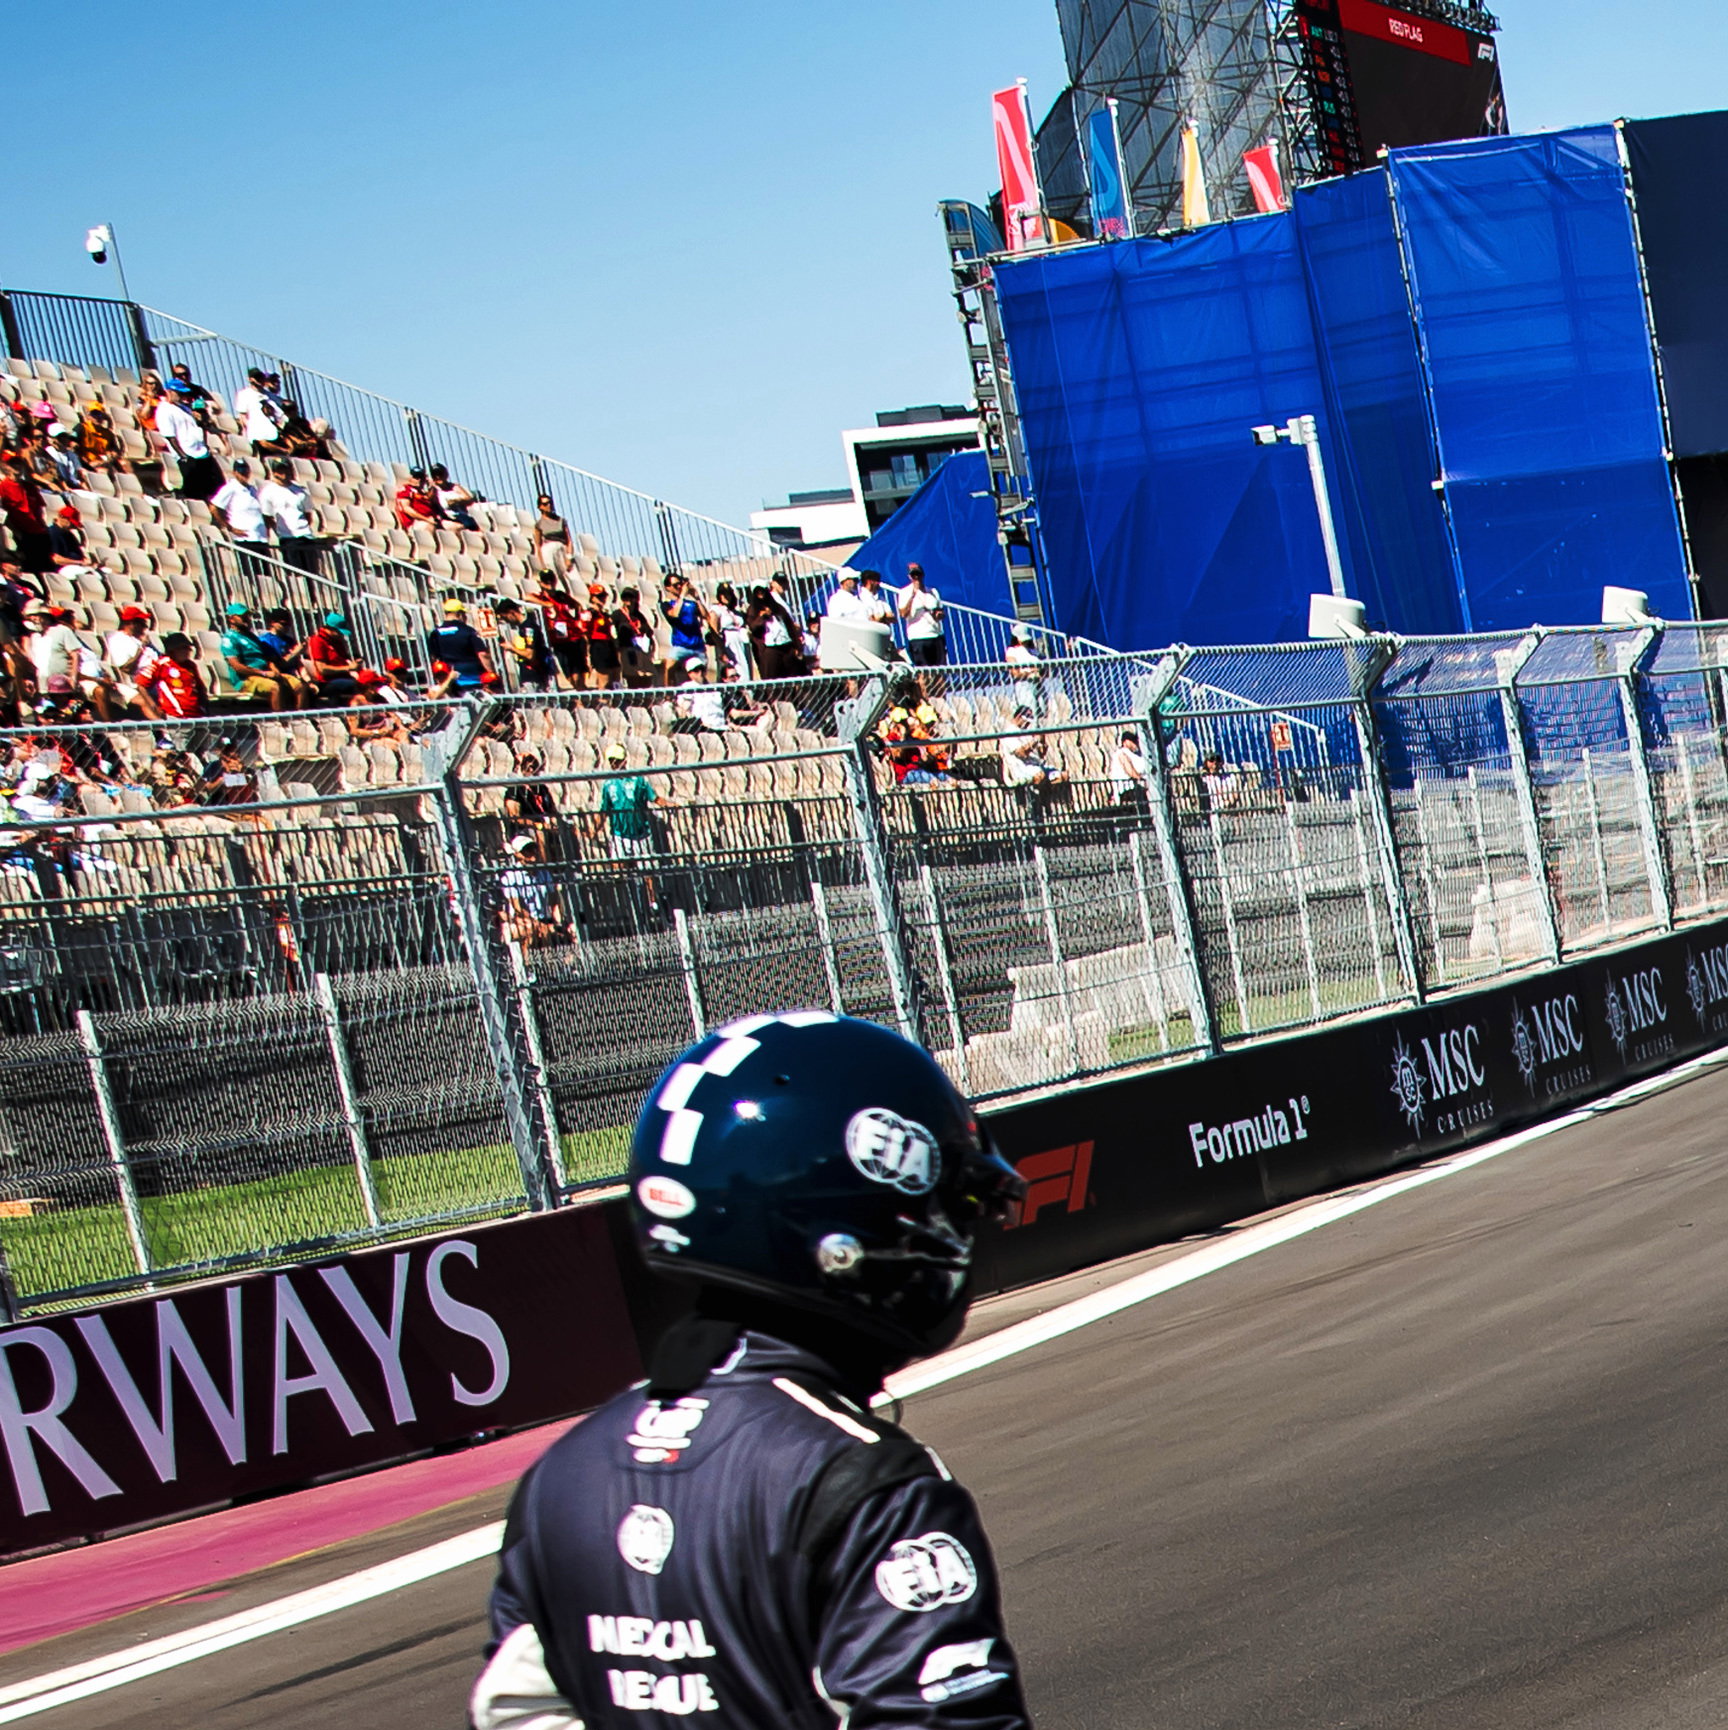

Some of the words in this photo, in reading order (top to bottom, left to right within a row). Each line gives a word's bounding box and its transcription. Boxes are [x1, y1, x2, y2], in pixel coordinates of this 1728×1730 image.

[1531, 994, 1584, 1063] MSC
[1622, 967, 1668, 1032] MSC
[1421, 1025, 1485, 1100] MSC
[1545, 1065, 1592, 1095] CRUISES
[1635, 1034, 1675, 1062] CRUISES
[1188, 1104, 1292, 1168] Formula
[1437, 1101, 1495, 1134] CRUISES
[0, 1240, 511, 1517] RWAYS
